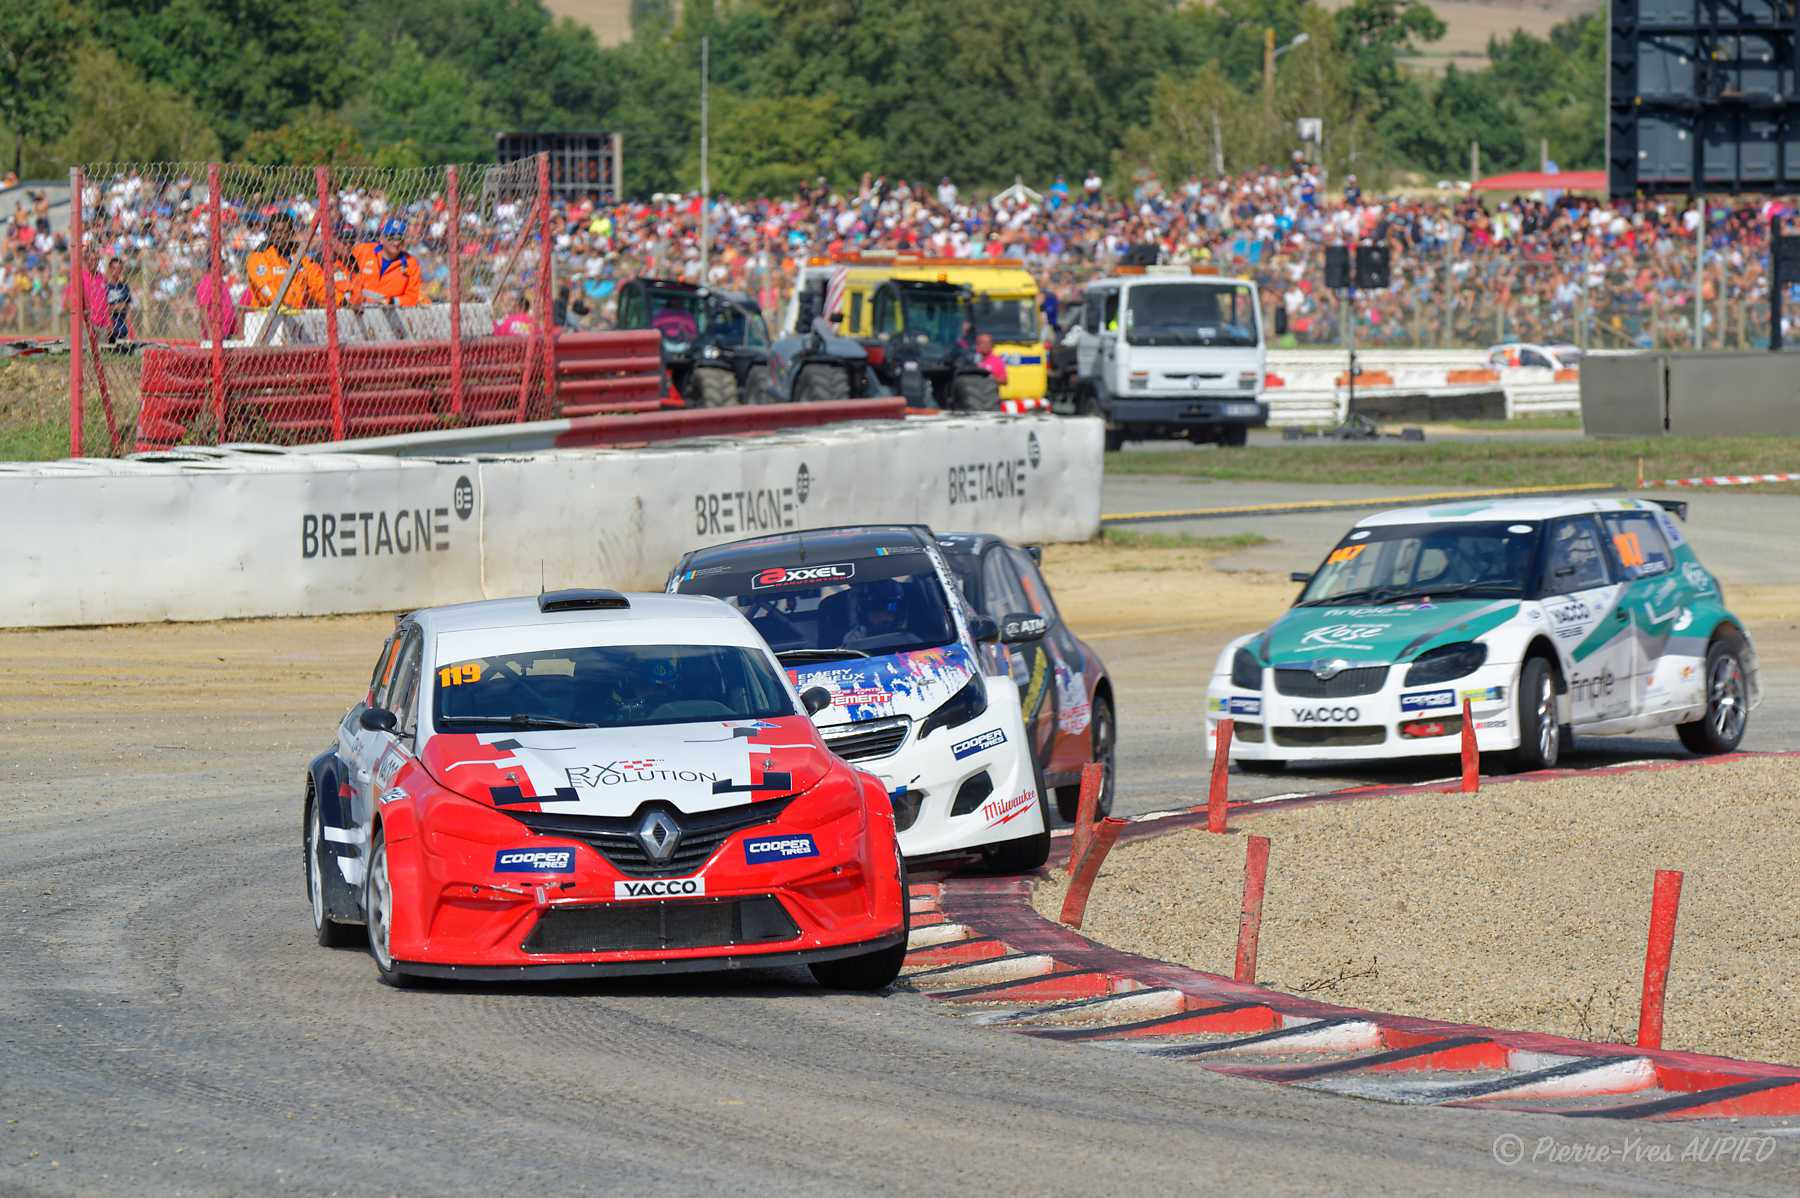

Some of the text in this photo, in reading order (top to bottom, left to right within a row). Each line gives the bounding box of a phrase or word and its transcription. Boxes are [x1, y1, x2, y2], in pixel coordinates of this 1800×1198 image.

[947, 459, 1025, 504] BRETAGNE
[695, 488, 793, 535] BRETAGNE
[302, 508, 449, 558] BRETAGNE
[438, 664, 481, 688] 119
[1291, 707, 1360, 722] YACCO
[953, 731, 1003, 753] COOPER
[980, 738, 1005, 750] TIRES
[565, 761, 621, 782] RX
[569, 769, 717, 788] EVOLUTION
[981, 789, 1035, 820] Milwaukee
[750, 839, 810, 853] COOPER
[780, 847, 812, 855] TIRES
[501, 852, 570, 864] COOPER
[624, 881, 697, 896] YACCO
